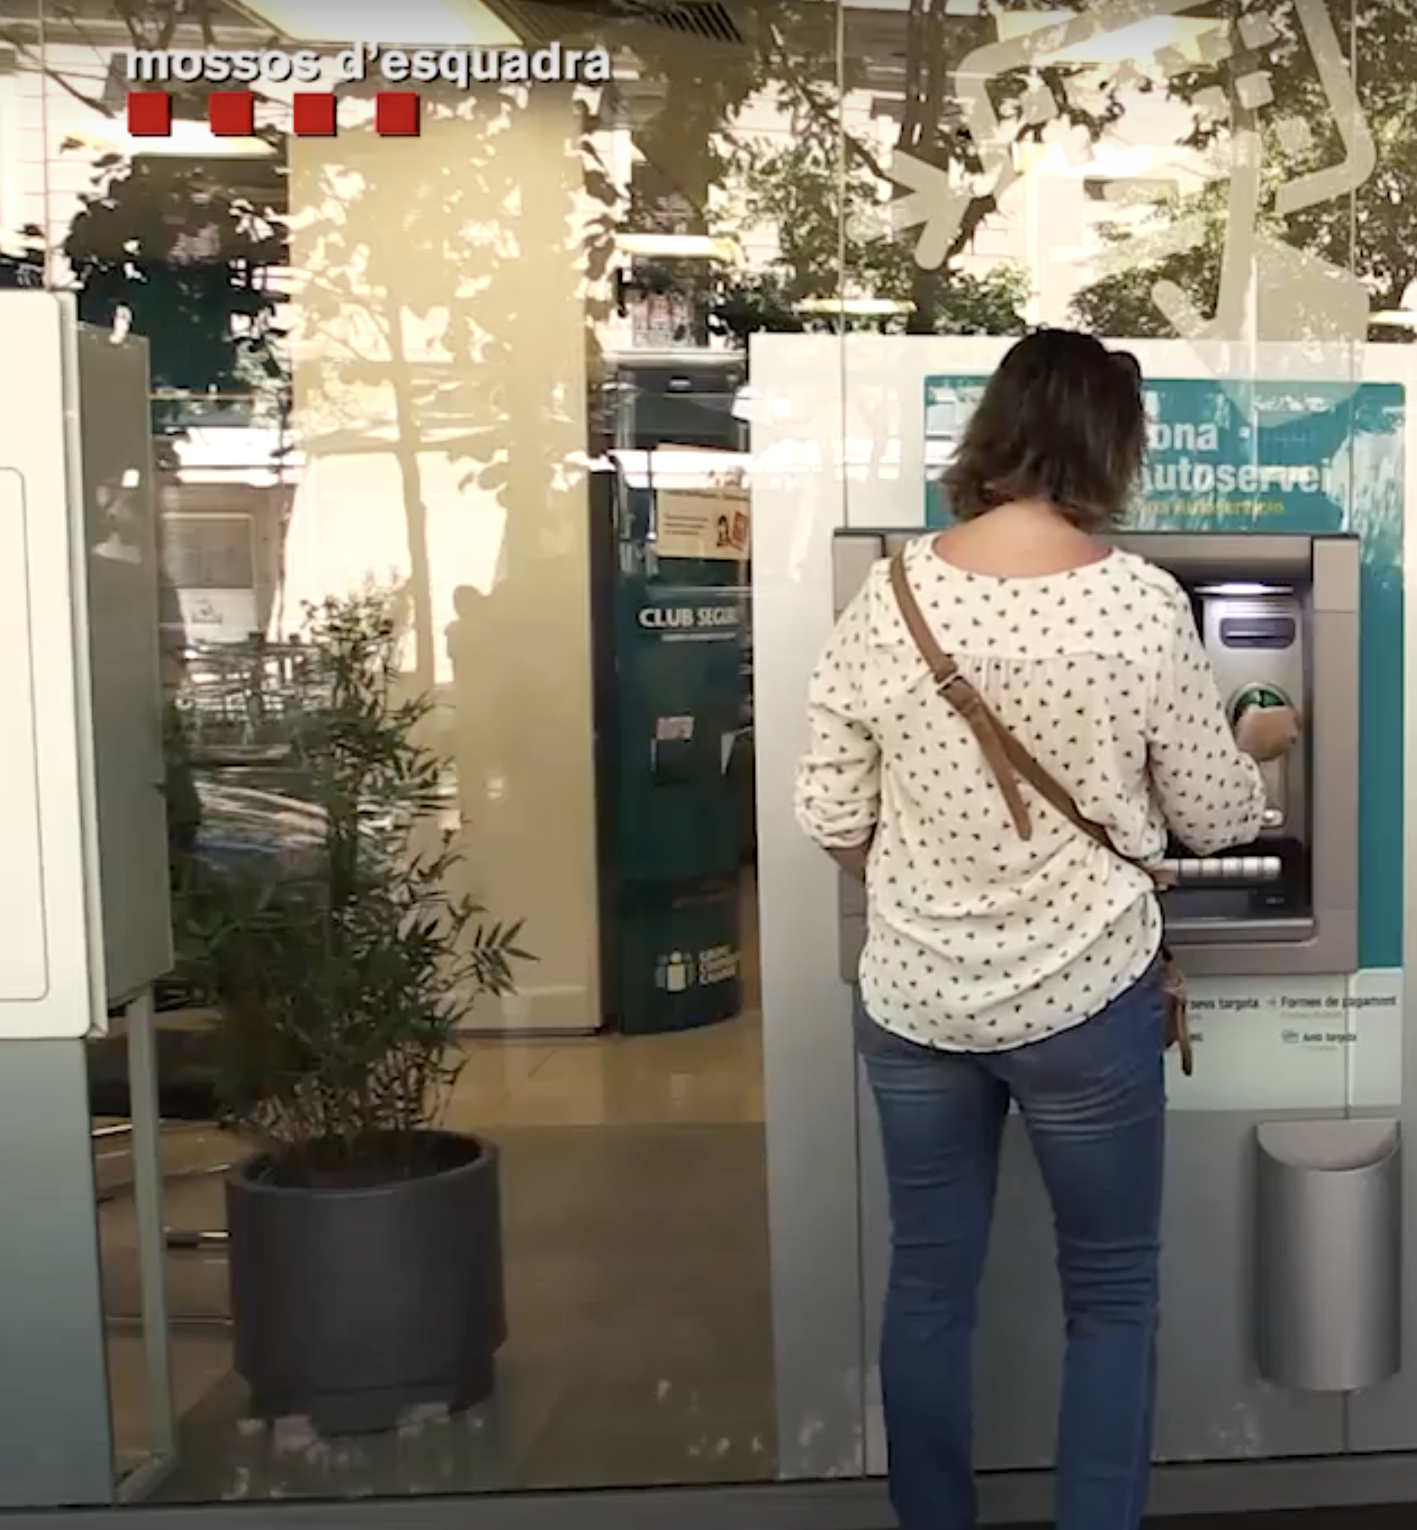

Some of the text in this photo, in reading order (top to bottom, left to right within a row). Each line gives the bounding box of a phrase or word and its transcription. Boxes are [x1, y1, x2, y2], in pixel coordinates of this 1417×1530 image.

[1146, 422, 1219, 451] ona
[638, 607, 693, 628] CLUB
[1281, 996, 1322, 1008] Formes
[1325, 995, 1340, 1007] de
